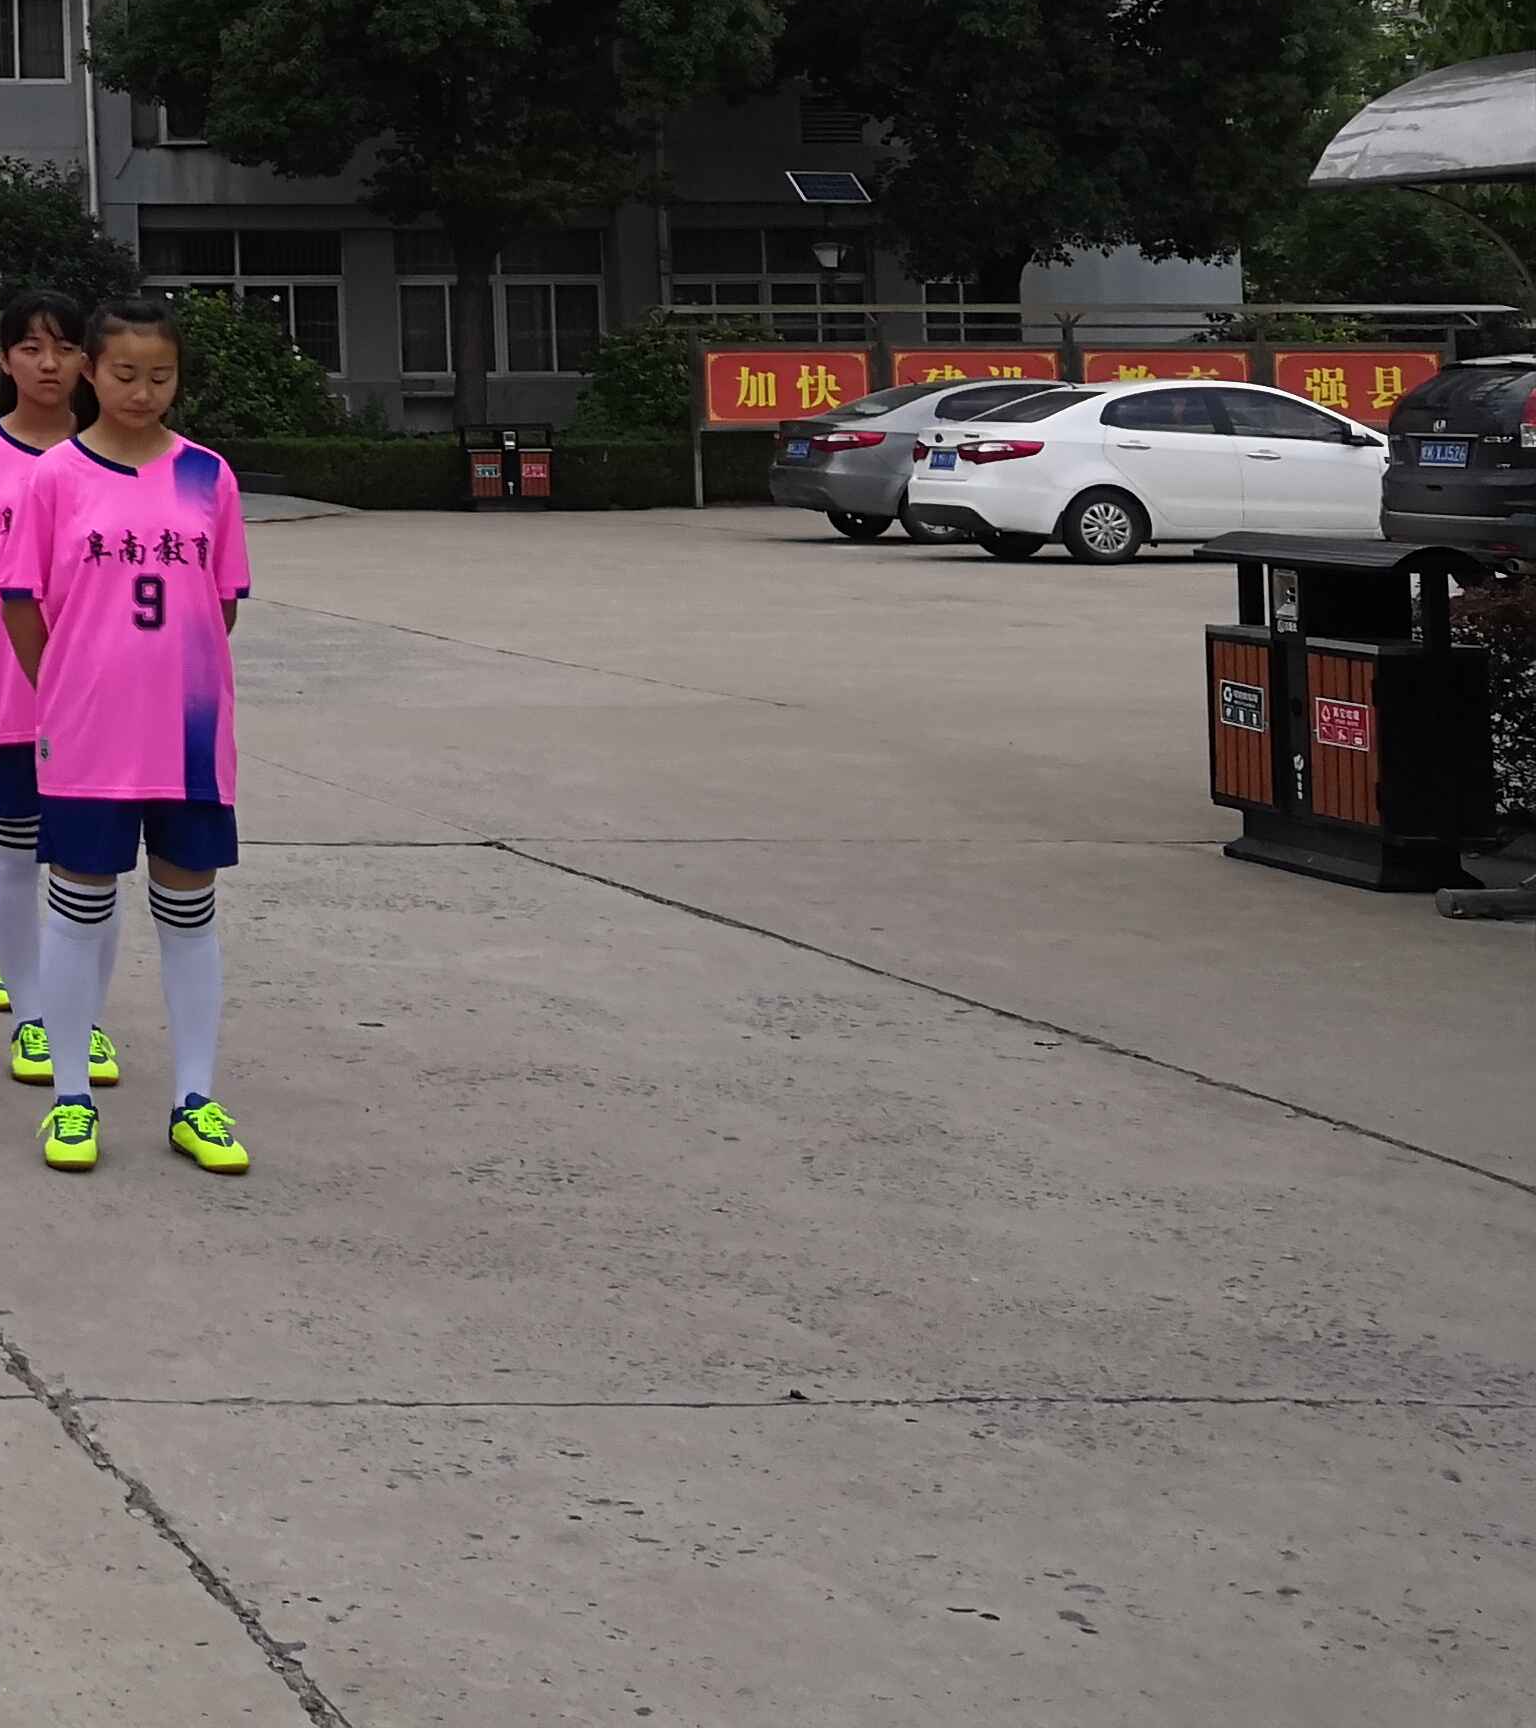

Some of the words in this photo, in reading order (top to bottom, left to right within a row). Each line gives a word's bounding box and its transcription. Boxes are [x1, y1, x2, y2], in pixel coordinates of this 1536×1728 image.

[736, 365, 841, 409] 加快
[1304, 366, 1407, 409] 强县
[83, 529, 209, 571] 阜南教育
[132, 573, 166, 631] 9
